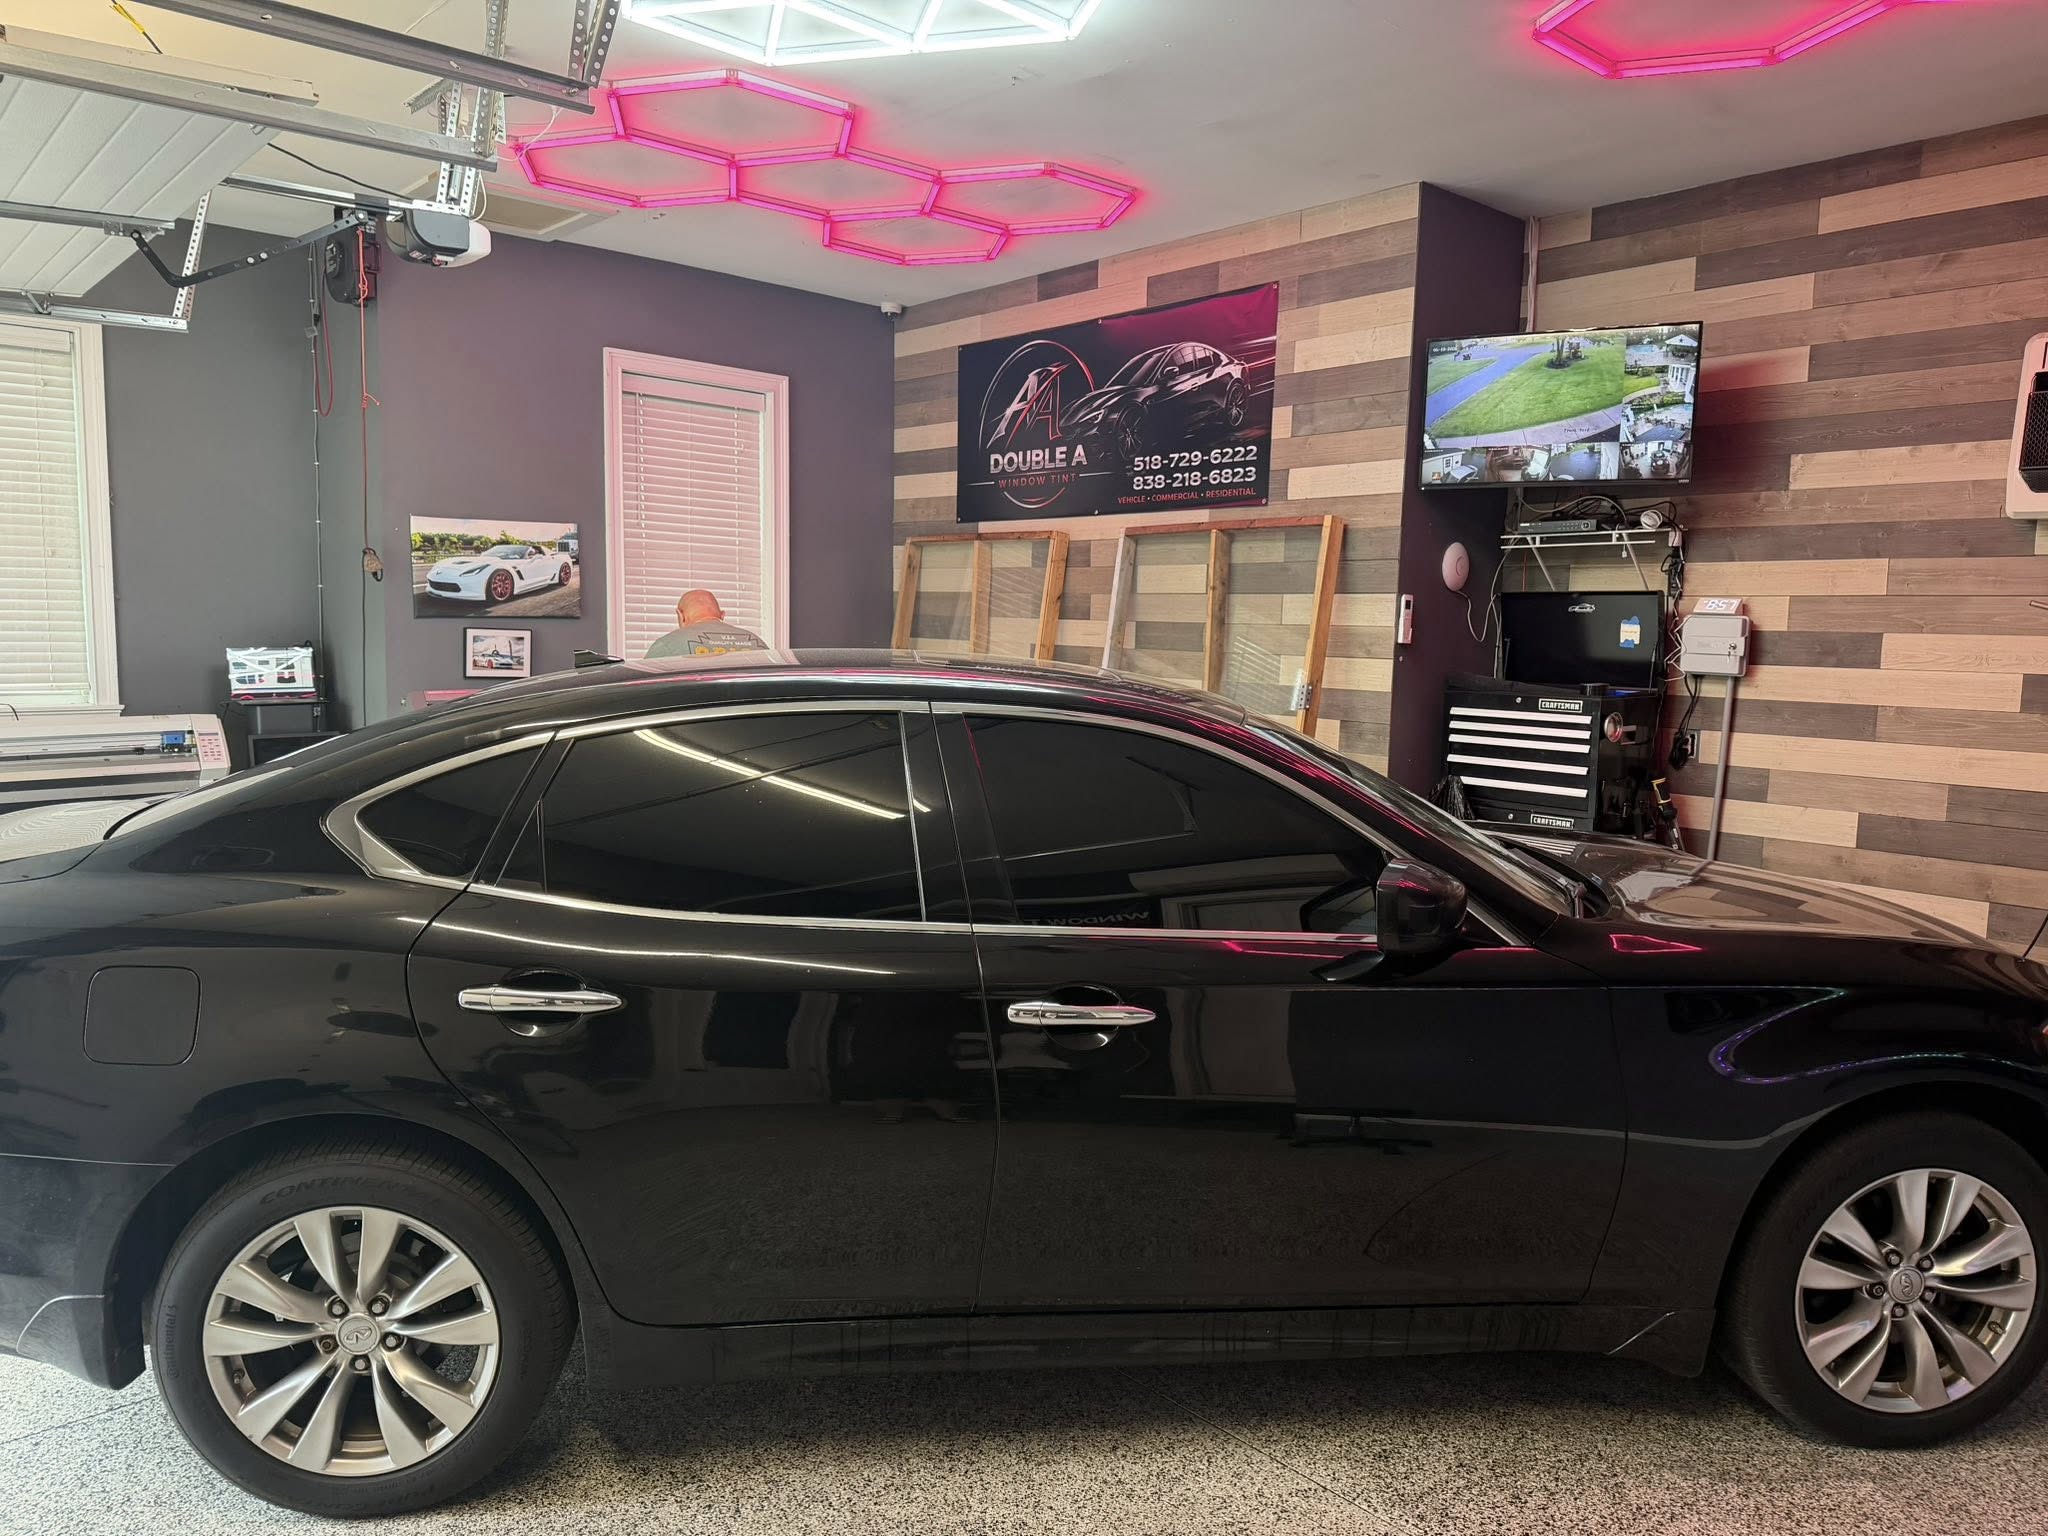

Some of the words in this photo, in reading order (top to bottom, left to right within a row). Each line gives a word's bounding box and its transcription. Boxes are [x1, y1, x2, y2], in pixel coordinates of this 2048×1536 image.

[990, 446, 1067, 474] DOUBLE
[1071, 444, 1088, 466] A
[1133, 445, 1258, 471] 518-729-6222
[999, 476, 1046, 489] WINDOW
[1051, 473, 1077, 483] TINT
[1133, 466, 1257, 490] 838-218-6823
[1118, 495, 1146, 504] VEHICLE
[1151, 491, 1199, 502] COMMERCIAL
[1205, 487, 1257, 498] RESIDENTIAL
[1541, 701, 1580, 710] CRAFTSMAN
[1533, 817, 1571, 828] CRAFTSMAN
